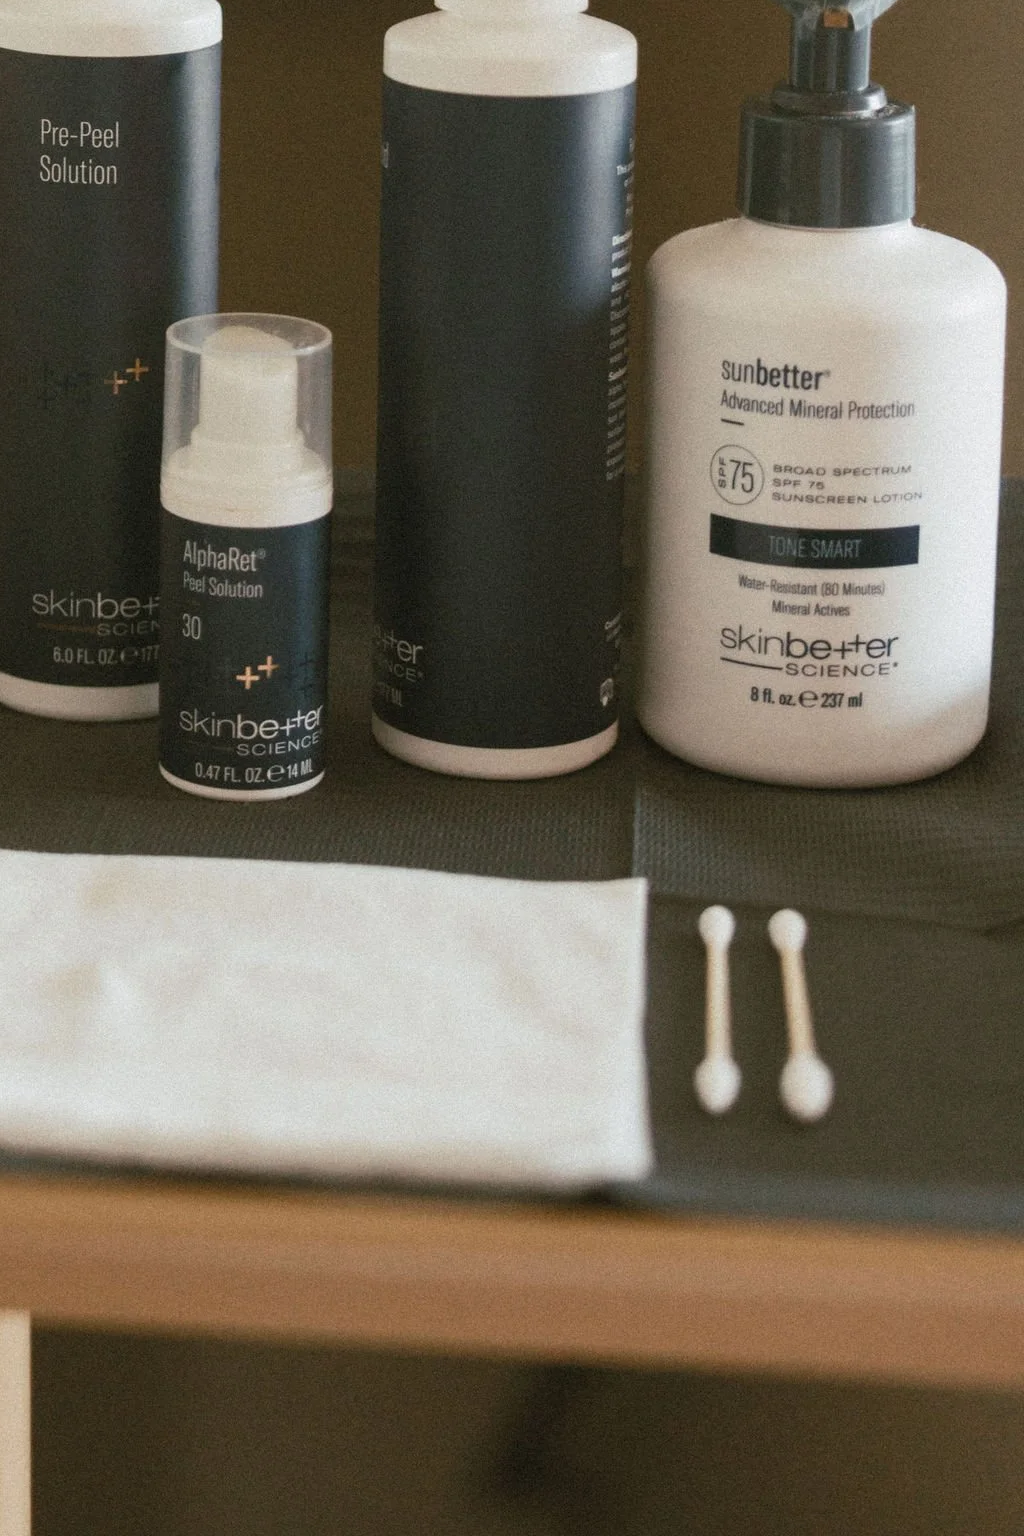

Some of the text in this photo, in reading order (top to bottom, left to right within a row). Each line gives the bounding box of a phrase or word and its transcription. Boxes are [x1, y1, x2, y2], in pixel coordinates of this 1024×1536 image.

[41, 118, 119, 148] Pre-Peel
[39, 154, 117, 184] Solution
[720, 390, 915, 420] Advanced Mineral Protection
[718, 456, 726, 489] SPF
[729, 459, 754, 493] 75
[773, 464, 912, 477] BROAD SPECTRUM
[772, 478, 825, 490] SPF 75
[772, 492, 922, 505] SUNSCREEN LOTION
[768, 535, 862, 559] TONE SMART
[183, 570, 264, 598] Peel Solution
[739, 574, 886, 598] Water-Resistant (80 Minutes)
[772, 600, 851, 617] Mineral Actives
[182, 613, 201, 640] 30
[53, 646, 73, 664] 6.0
[750, 686, 759, 703] 8
[763, 687, 775, 704] fl.
[779, 693, 796, 706] oz.
[820, 692, 845, 708] 237
[848, 692, 863, 707] ml
[195, 762, 221, 781] 0.47
[224, 766, 241, 782] FL.
[244, 767, 265, 783] OZ.
[287, 762, 299, 780] 14
[300, 758, 314, 776] ML
